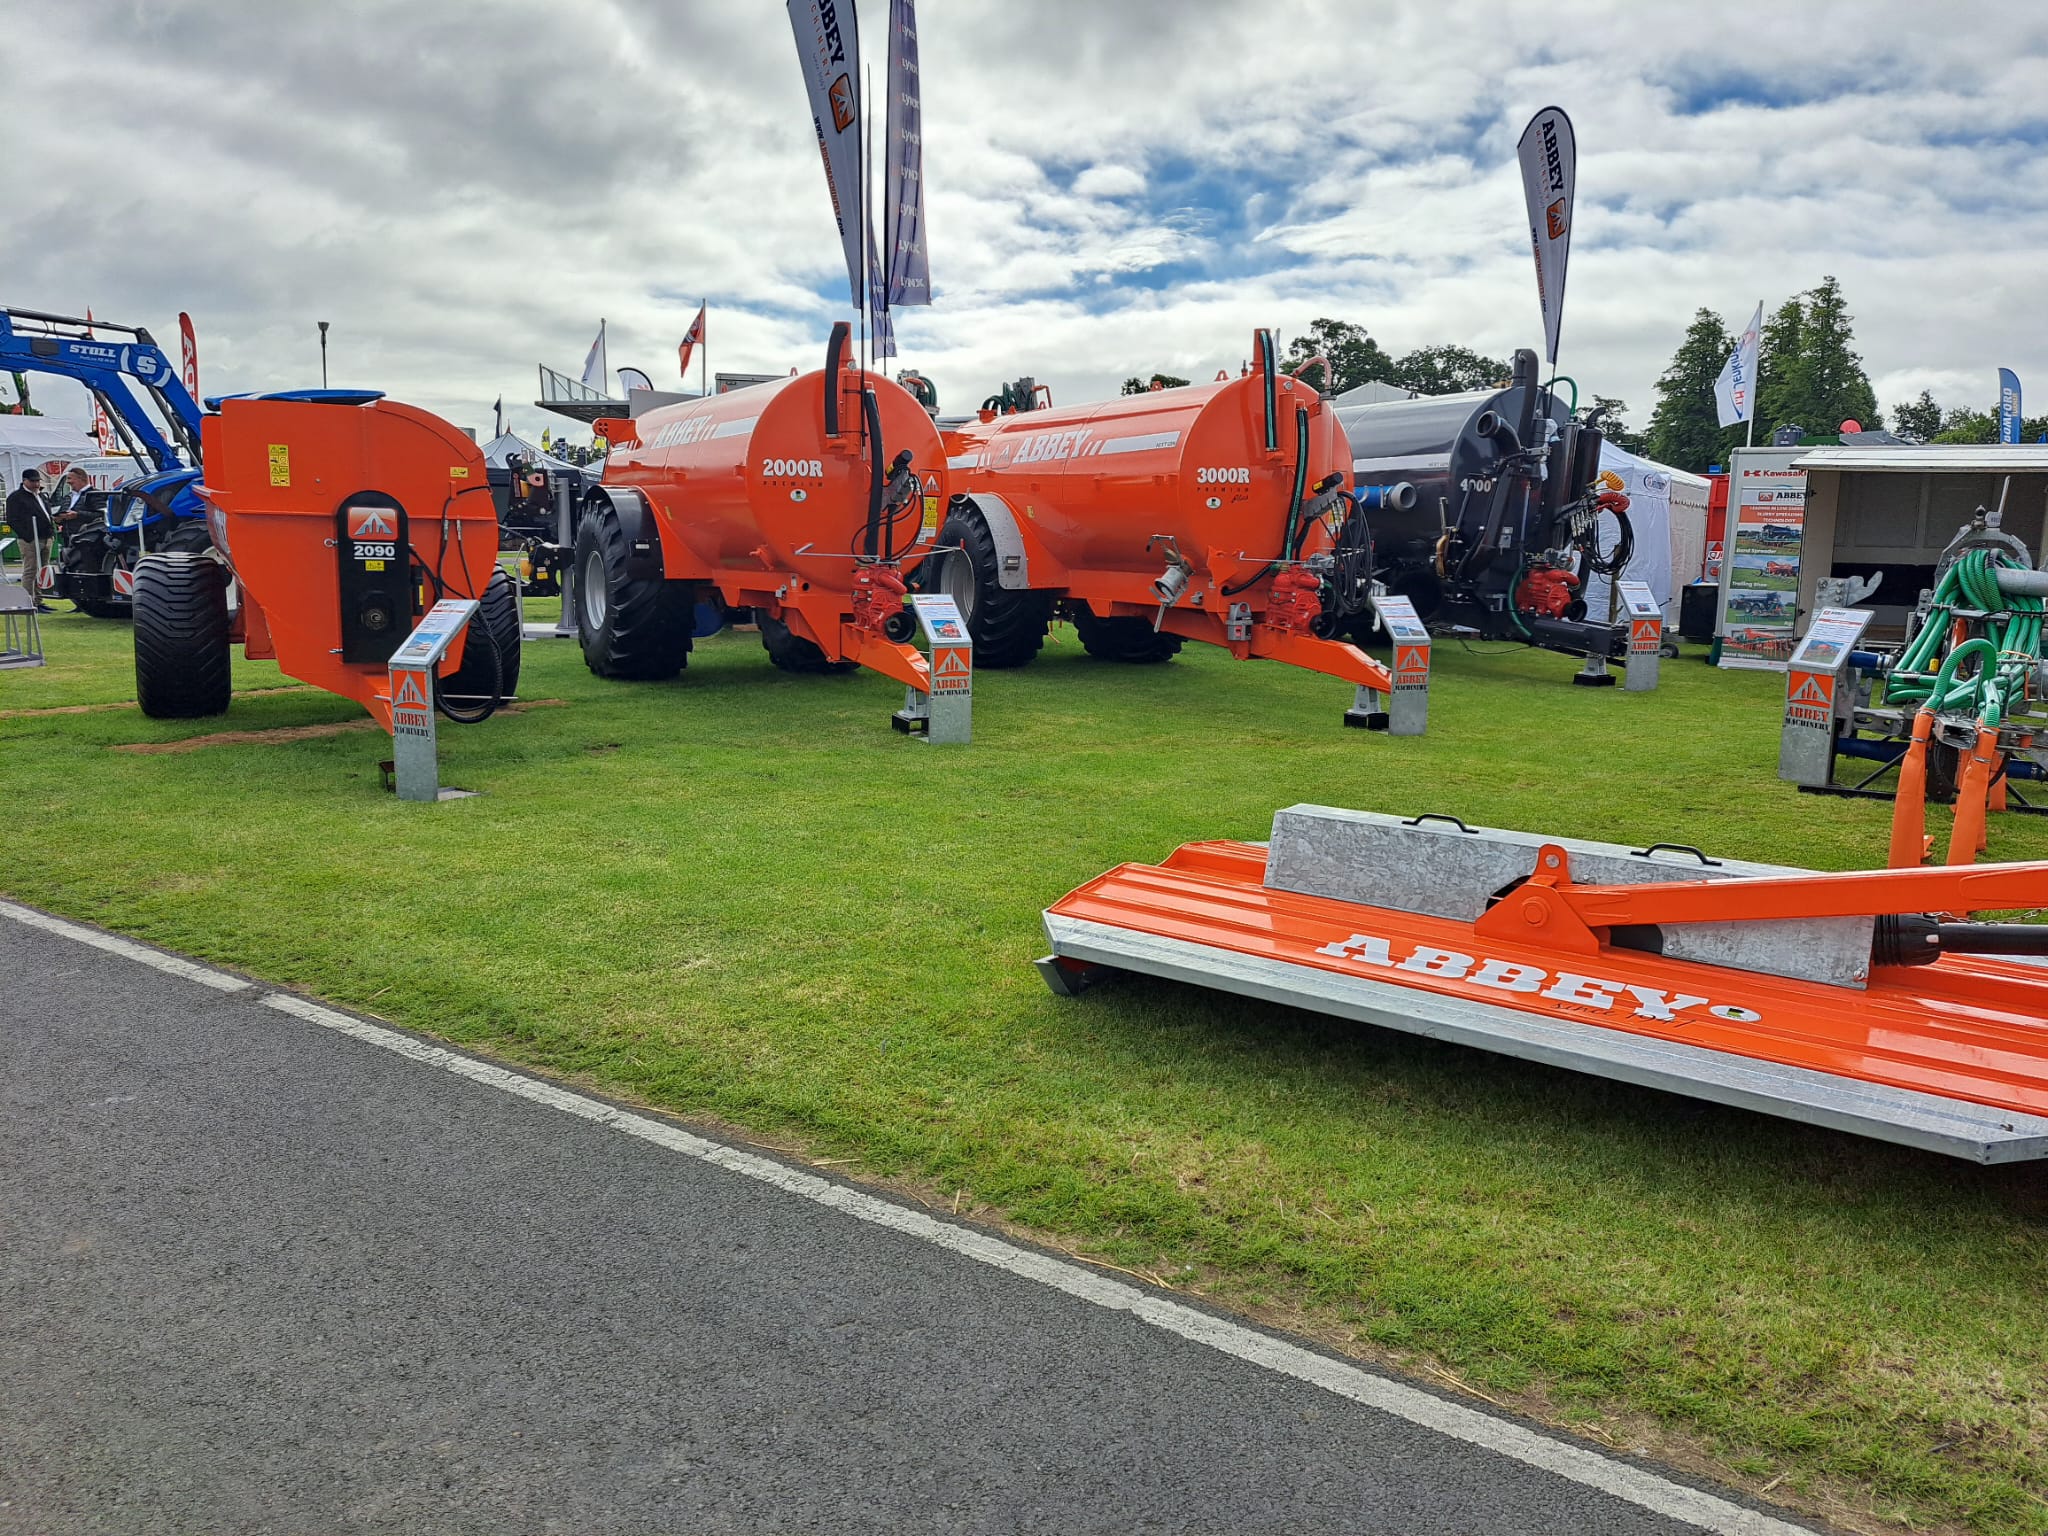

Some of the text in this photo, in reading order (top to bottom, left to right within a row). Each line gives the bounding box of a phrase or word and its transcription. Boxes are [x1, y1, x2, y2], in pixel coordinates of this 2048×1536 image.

[810, 0, 832, 77] CHINERY
[1542, 118, 1564, 192] ABBEY
[69, 344, 116, 358] STOLL
[1012, 429, 1094, 464] ABBEY
[762, 458, 823, 478] 2000R
[1196, 467, 1250, 484] 3000R
[1460, 478, 1498, 493] 4000
[353, 545, 395, 557] 2090
[935, 679, 969, 689] ABBEY
[394, 711, 427, 727] ABBEY
[1787, 706, 1829, 723] ABBEY
[1785, 717, 1830, 731] MACHINERY
[1315, 933, 1710, 1021] ABBEY
